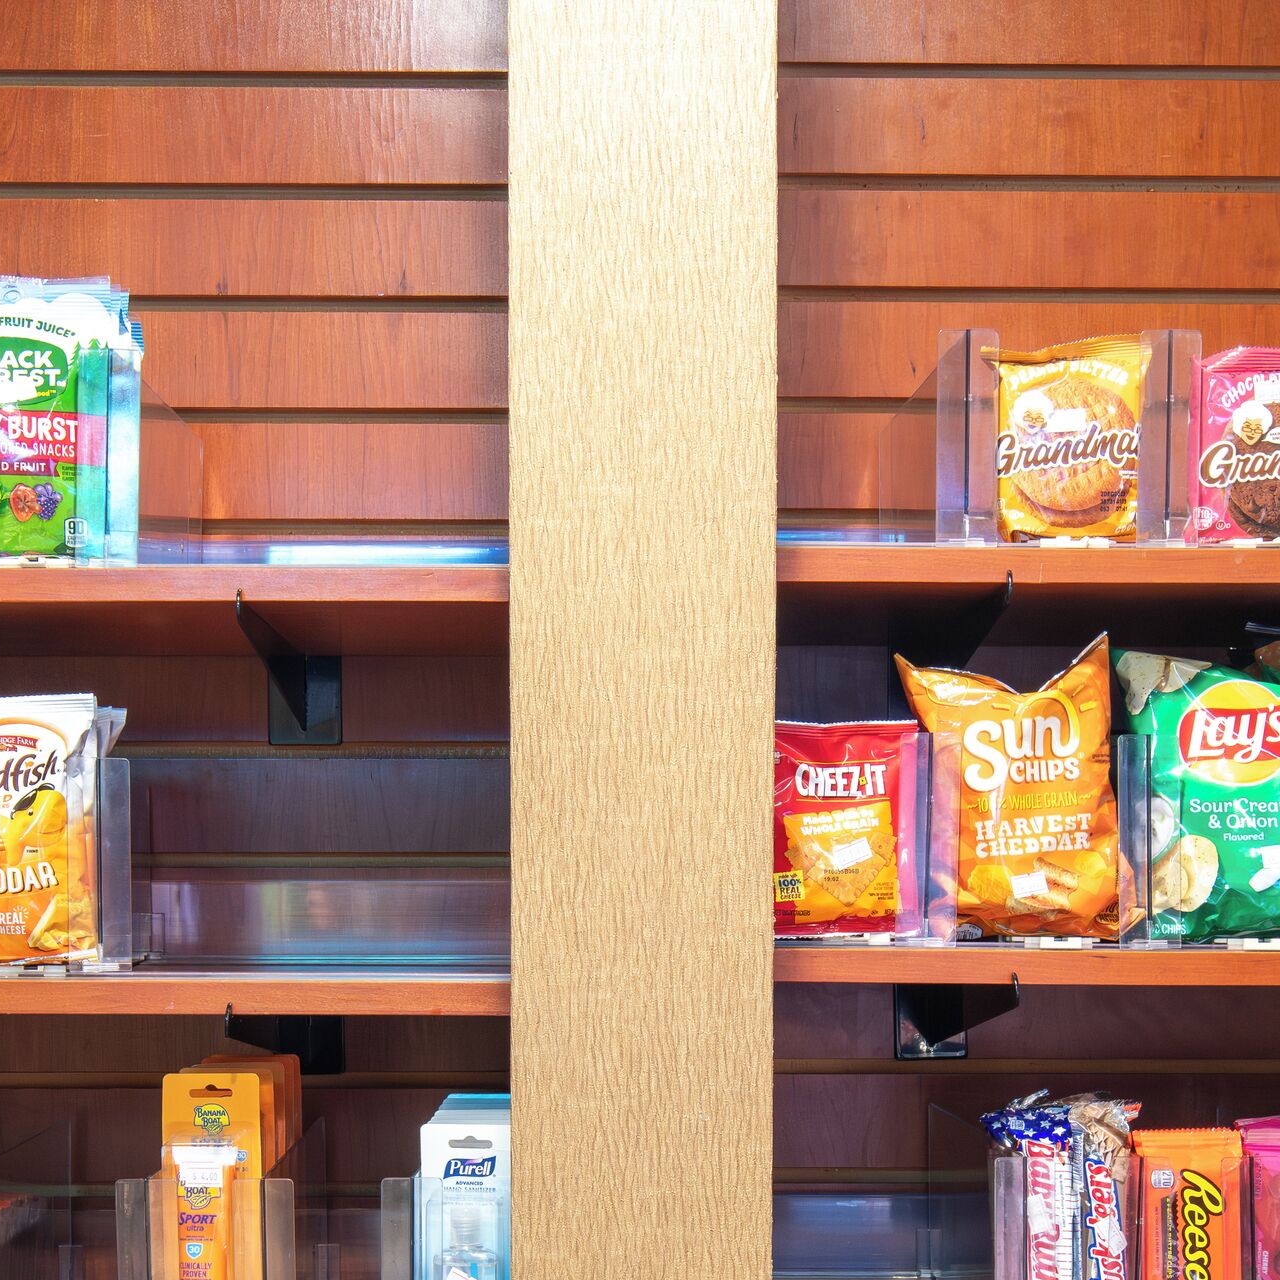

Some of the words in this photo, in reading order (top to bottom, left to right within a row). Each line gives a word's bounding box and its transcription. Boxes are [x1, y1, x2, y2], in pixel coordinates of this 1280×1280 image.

[1009, 361, 1067, 389] PEANUT
[1070, 361, 1129, 385] BUTTER
[8, 416, 78, 443] BURST
[14, 463, 46, 472] FRUIT
[18, 737, 34, 745] FARM
[1010, 759, 1080, 782] CHIPS
[1190, 799, 1232, 812] Sour
[976, 814, 1091, 841] HARVEST
[976, 833, 1091, 858] CHEDDAR
[197, 1109, 226, 1118] BANANA
[450, 1160, 491, 1176] Purell
[179, 1215, 216, 1225] SPORT
